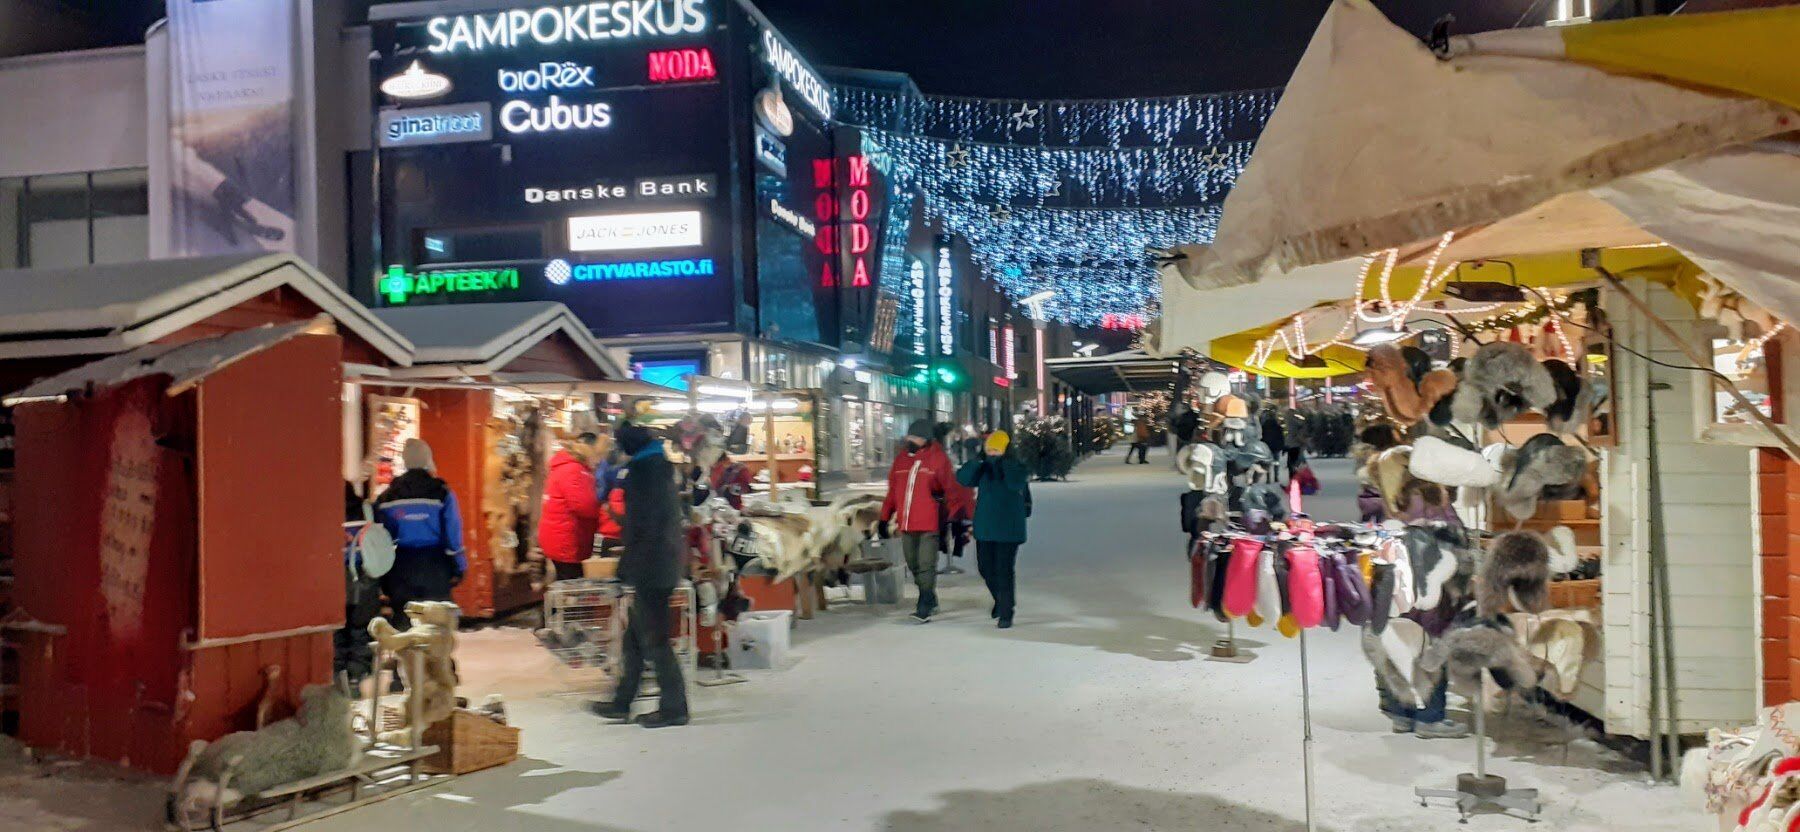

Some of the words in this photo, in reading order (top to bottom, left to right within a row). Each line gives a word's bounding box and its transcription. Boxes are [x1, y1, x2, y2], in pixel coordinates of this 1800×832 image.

[426, 0, 707, 53] SAMPOKESKUS
[648, 48, 716, 81] MODA
[763, 29, 831, 120] SAMPOKESKUS
[500, 95, 612, 134] Cubus
[525, 185, 626, 203] Danske
[640, 179, 709, 196] Bank
[576, 229, 617, 240] JACK
[636, 223, 689, 237] JONES
[847, 155, 871, 286] MODA
